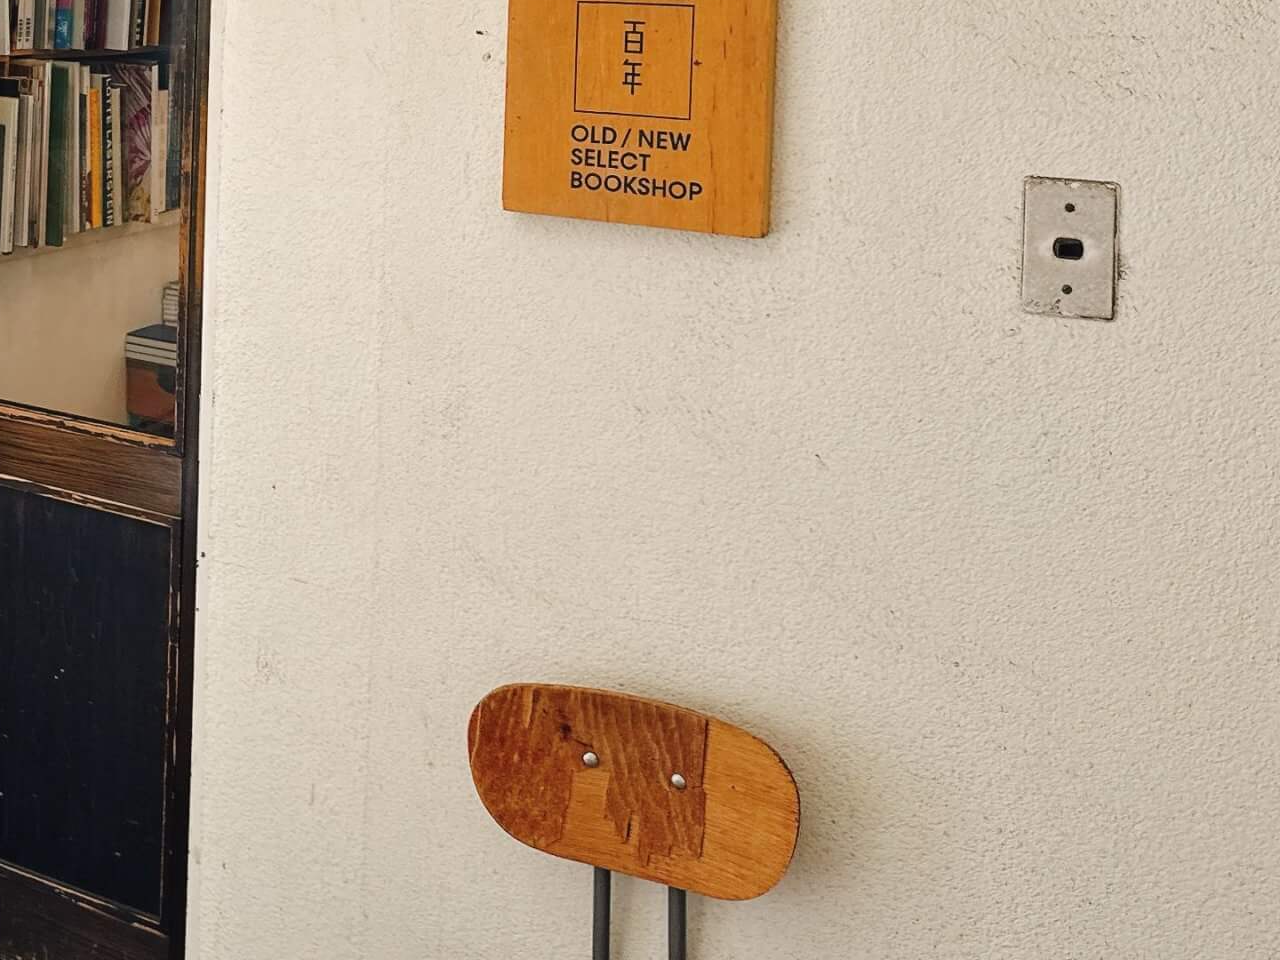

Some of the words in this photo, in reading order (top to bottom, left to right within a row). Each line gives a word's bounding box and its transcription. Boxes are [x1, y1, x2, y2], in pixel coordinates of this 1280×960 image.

[622, 20, 646, 96] 百年
[571, 148, 651, 172] SELECT
[571, 171, 703, 201] BOOKSHOP
